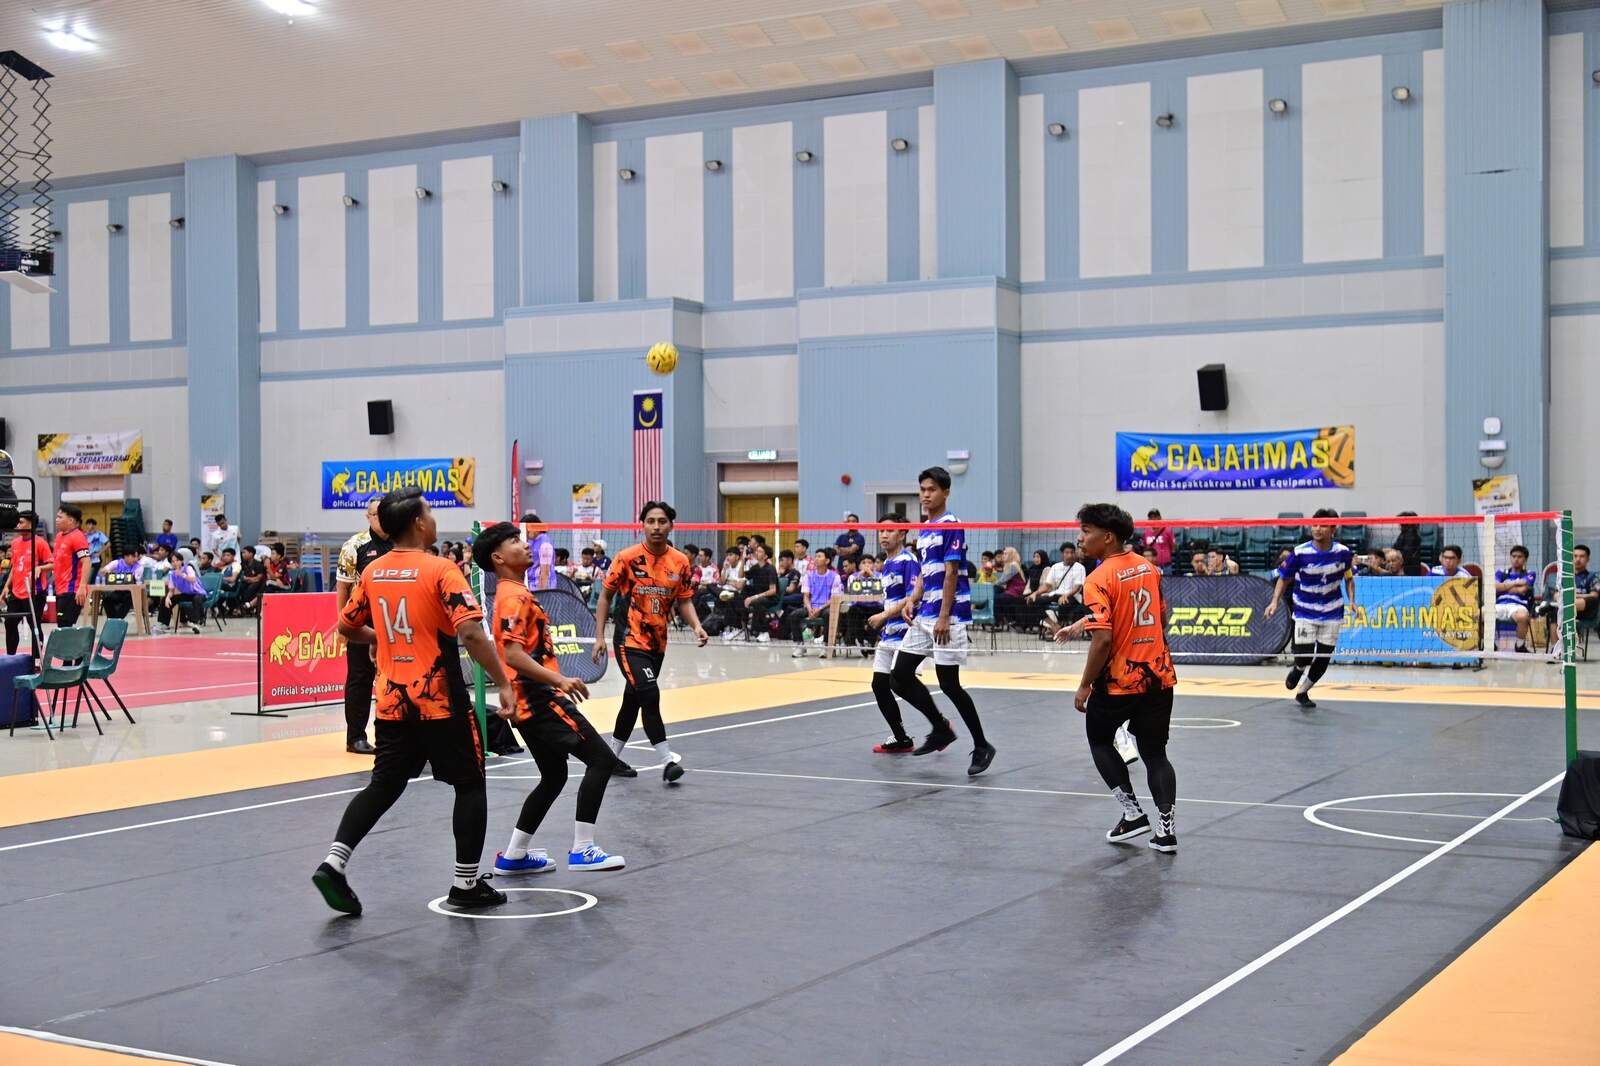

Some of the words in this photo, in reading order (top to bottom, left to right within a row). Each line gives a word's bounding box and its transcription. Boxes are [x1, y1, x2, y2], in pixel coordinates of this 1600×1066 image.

[1166, 440, 1330, 472] GAJAHMAS
[356, 468, 460, 494] GAJAHMAS
[1131, 478, 1168, 489] Official
[1170, 478, 1232, 491] Sepaktakraw
[1235, 479, 1256, 488] Ball
[1270, 477, 1324, 488] Equipment
[332, 500, 356, 508] Official
[425, 499, 456, 508] quipment
[1130, 586, 1156, 626] 12
[378, 597, 413, 643] 14
[1168, 607, 1253, 625] PRO
[1167, 625, 1252, 637] APPAREL
[643, 667, 654, 679] 13
[271, 686, 298, 697] Official
[300, 684, 345, 695] Sepaktakraw
